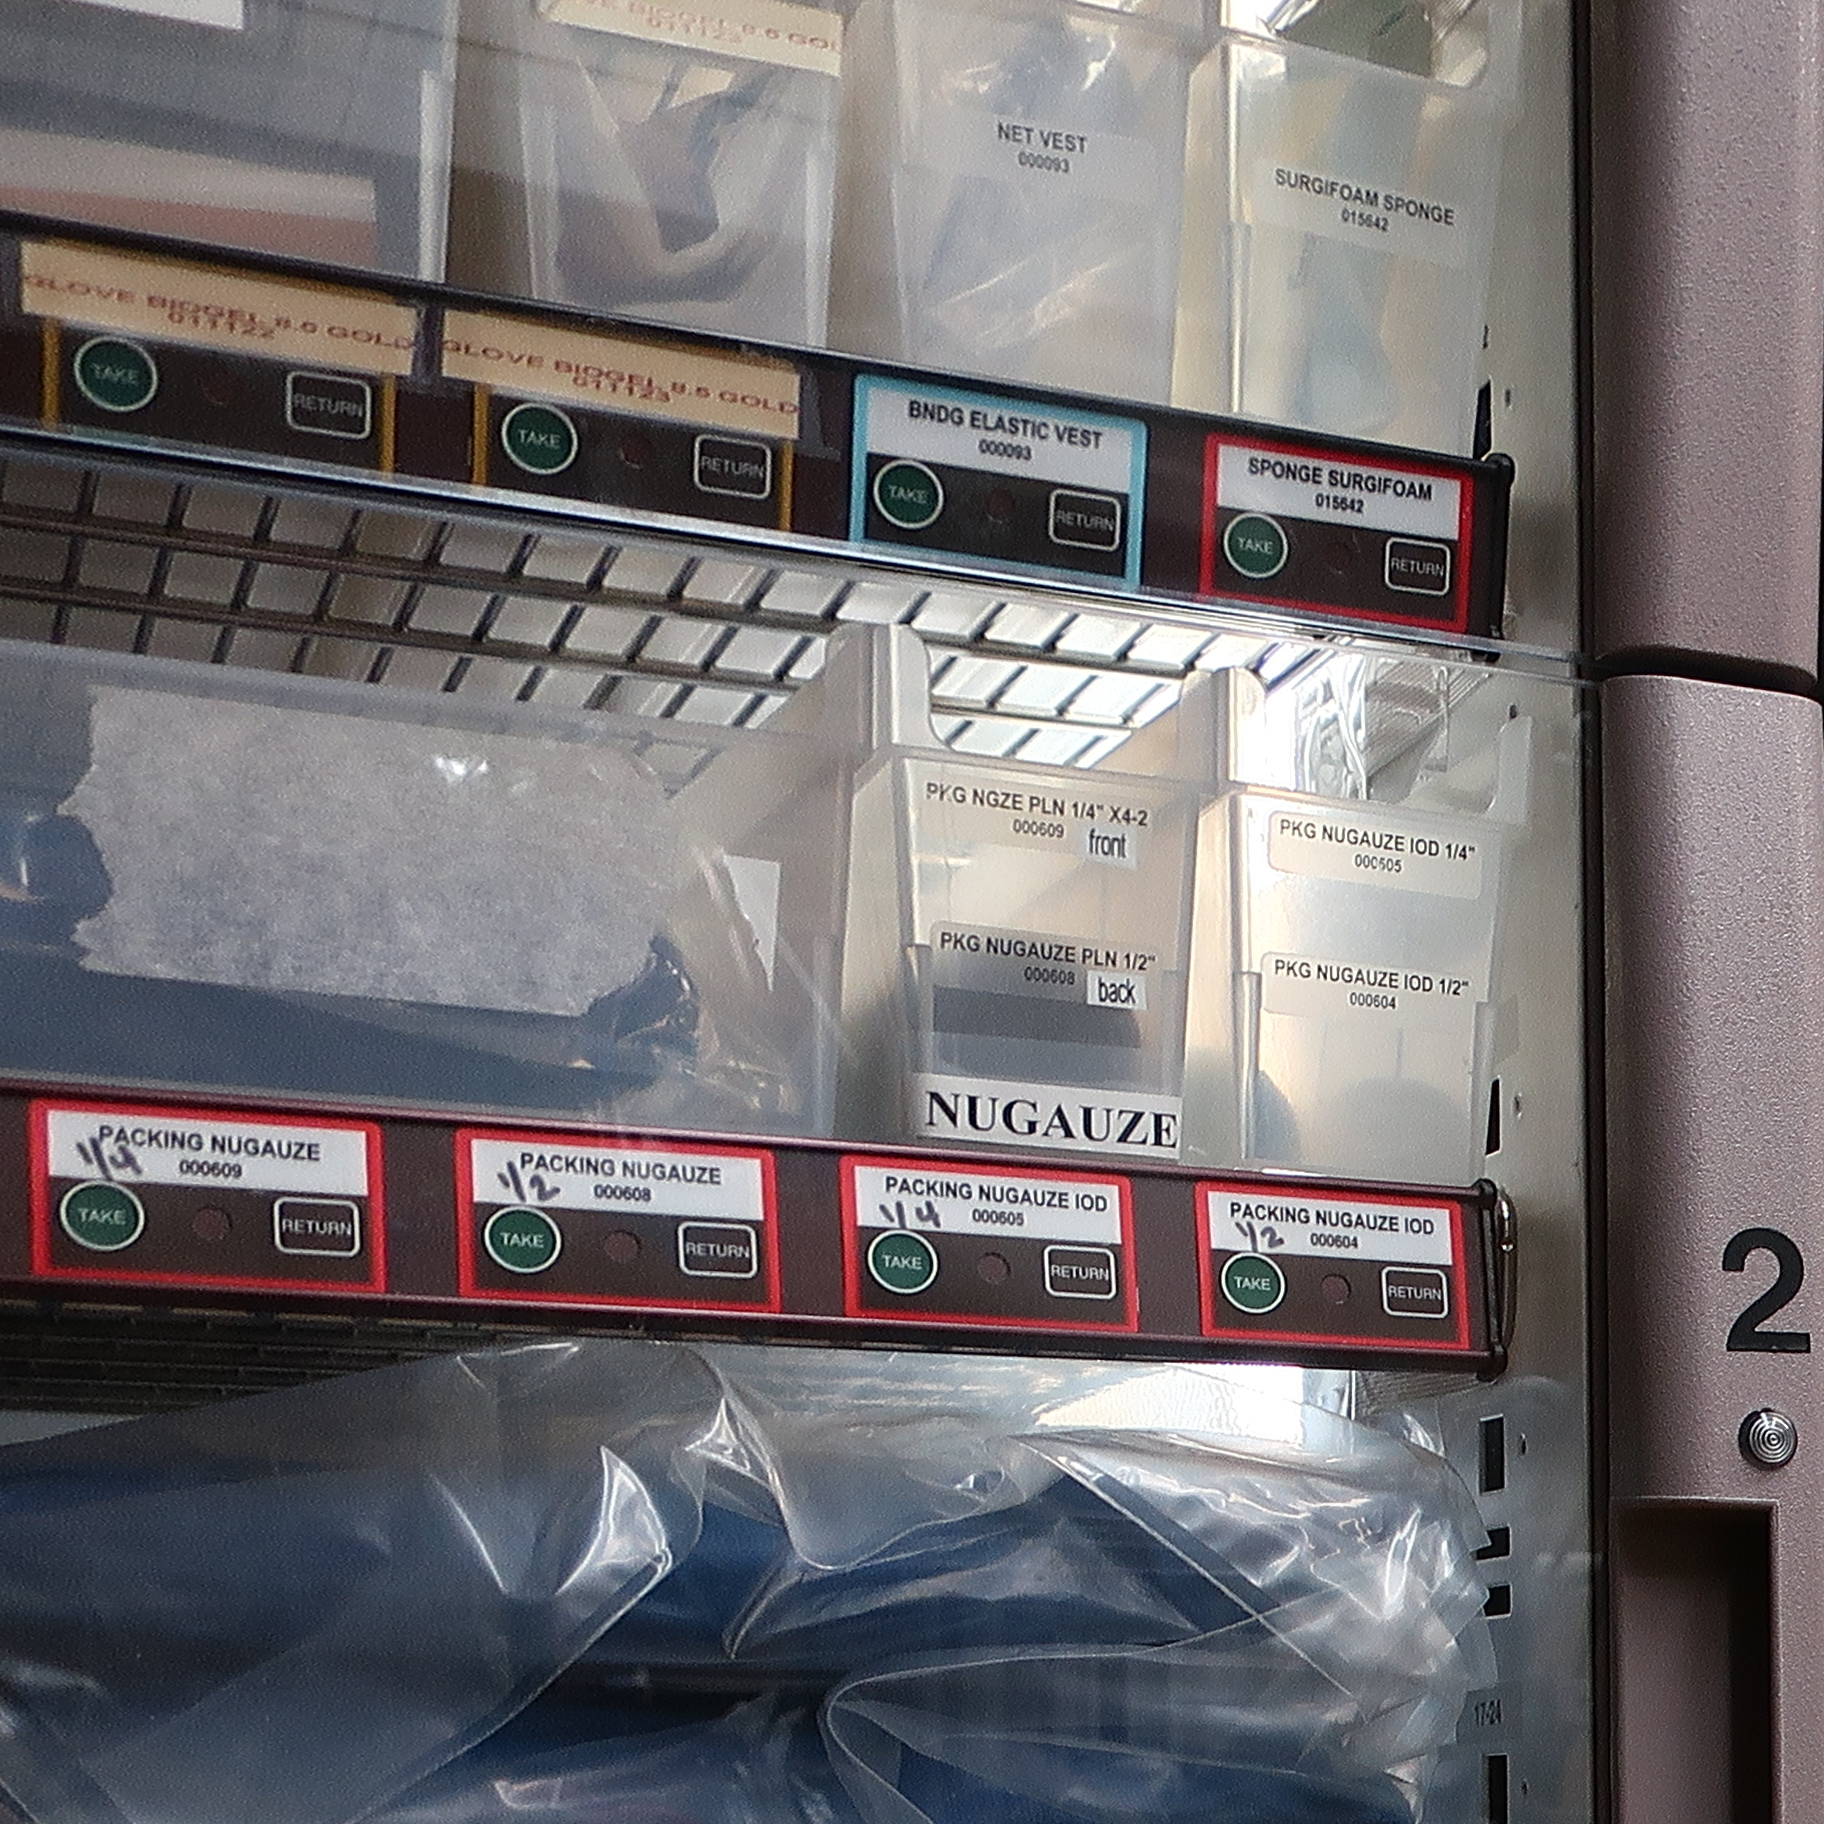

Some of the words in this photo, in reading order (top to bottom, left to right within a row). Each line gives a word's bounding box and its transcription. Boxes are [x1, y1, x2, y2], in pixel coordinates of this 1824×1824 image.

[996, 121, 1034, 148] NET
[1038, 127, 1088, 156] VEST
[1275, 168, 1380, 211] SURGIFOAM
[1384, 193, 1456, 228] SPONGE
[327, 325, 415, 349] GOLD
[443, 339, 544, 368] GLOVE
[718, 389, 798, 415] GOLD
[908, 401, 965, 430] BNDG
[970, 411, 1050, 440] ELASTIC
[1055, 423, 1103, 450] VEST
[1248, 457, 1323, 487] SPONGE
[1327, 469, 1433, 502] SURGIFOAM
[1236, 535, 1274, 555] TAKE
[926, 781, 967, 805] PKG
[972, 788, 1022, 811] NGZE
[1029, 795, 1065, 816] PLN
[1088, 829, 1127, 860] front
[1279, 819, 1318, 841] PKG
[1320, 824, 1405, 853] NUGAUZE
[1408, 835, 1441, 856] IOD
[940, 932, 980, 953] PKG
[985, 937, 1077, 963] NUGAUZE
[1082, 946, 1117, 967] PLN
[1097, 977, 1138, 1004] back
[1274, 960, 1312, 979] PKG
[1315, 964, 1401, 990] NUGAUZE
[1403, 974, 1434, 993] IOD
[925, 1091, 1178, 1149] NUGAUZE
[99, 1124, 204, 1151] PACKING
[211, 1135, 321, 1162] NUGAUZE
[520, 1152, 615, 1177] PACKING
[622, 1160, 722, 1185] NUGAUZE
[886, 1176, 972, 1200] PACKING
[979, 1183, 1069, 1208] NUGAUZE
[1075, 1193, 1107, 1212] IOD
[1230, 1202, 1310, 1224] PACKING
[1315, 1210, 1399, 1232] NUGAUZE
[1405, 1218, 1434, 1235] IOD
[686, 1242, 749, 1259] RETURN
[882, 1254, 922, 1270] TAKE
[1722, 1227, 1811, 1353] 2
